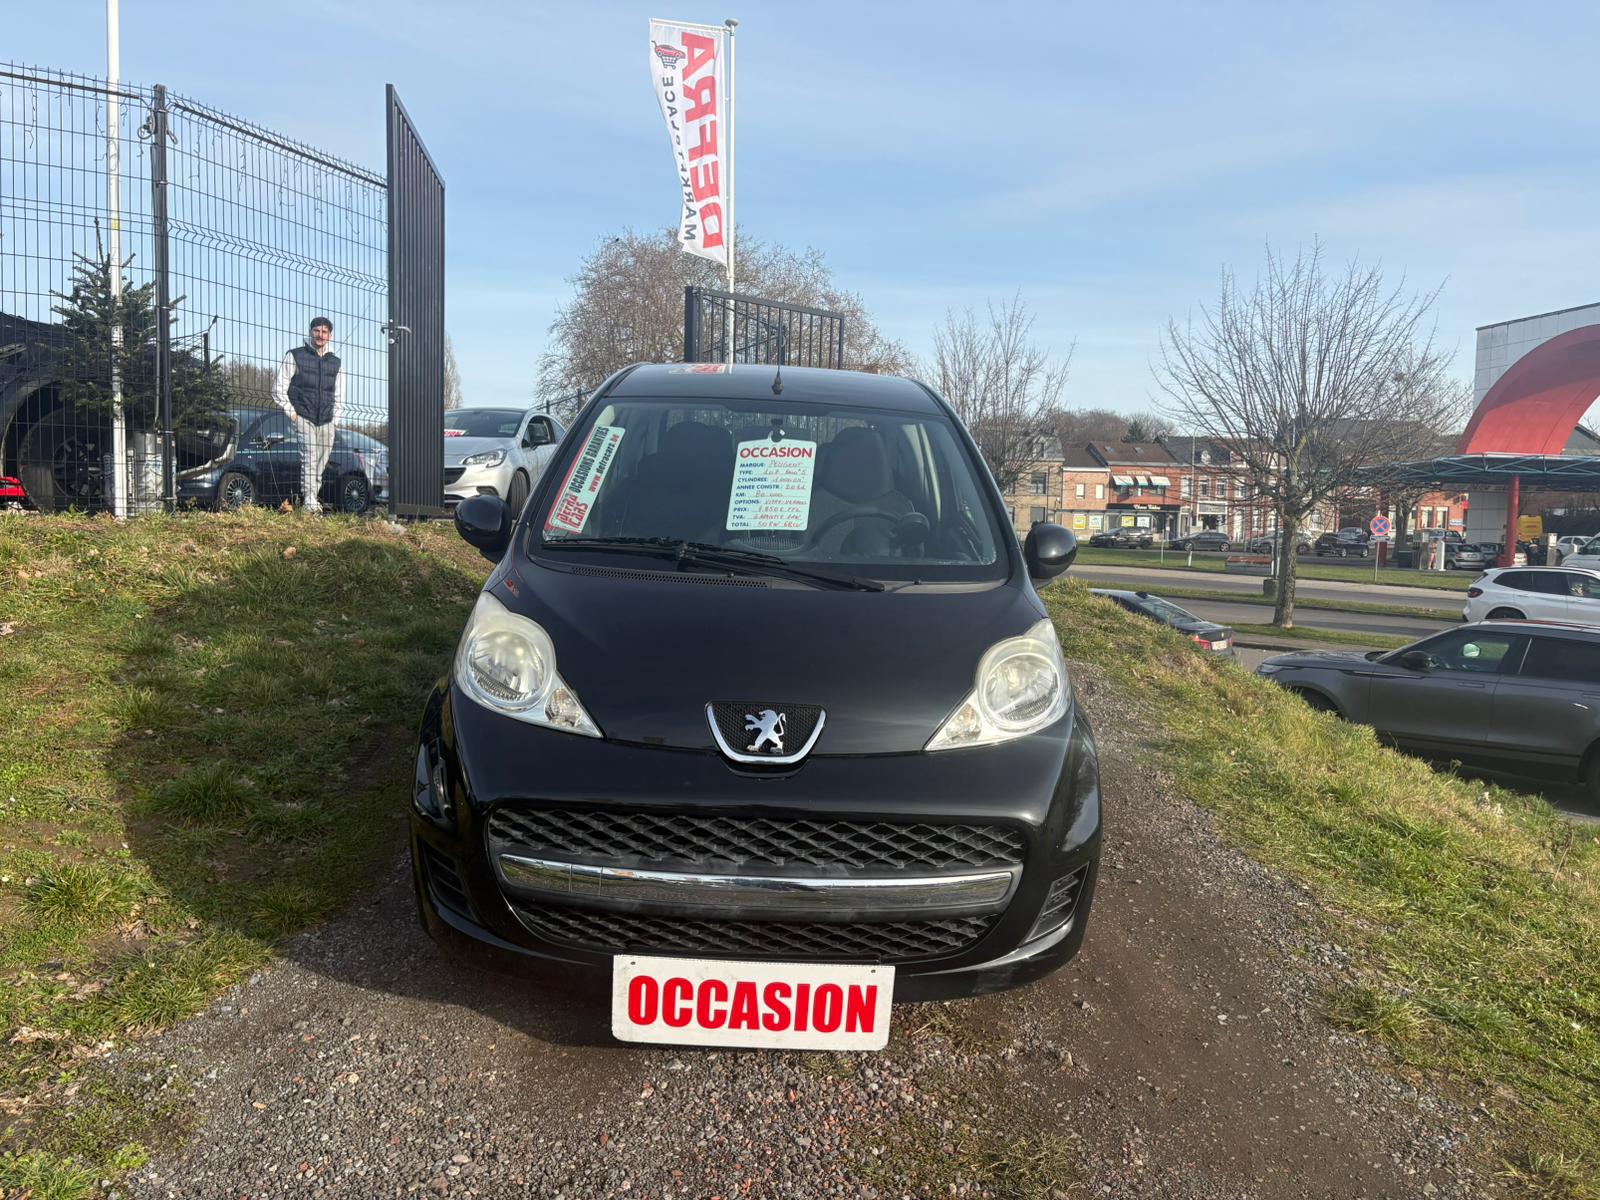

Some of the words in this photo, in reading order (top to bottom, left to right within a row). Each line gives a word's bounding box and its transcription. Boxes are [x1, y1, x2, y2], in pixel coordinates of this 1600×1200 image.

[568, 456, 595, 493] OCCASIONS
[585, 426, 611, 458] GARANTIES
[588, 434, 620, 492] www.defracars.be
[739, 447, 812, 458] OCCASION
[628, 975, 878, 1033] OCCASION
